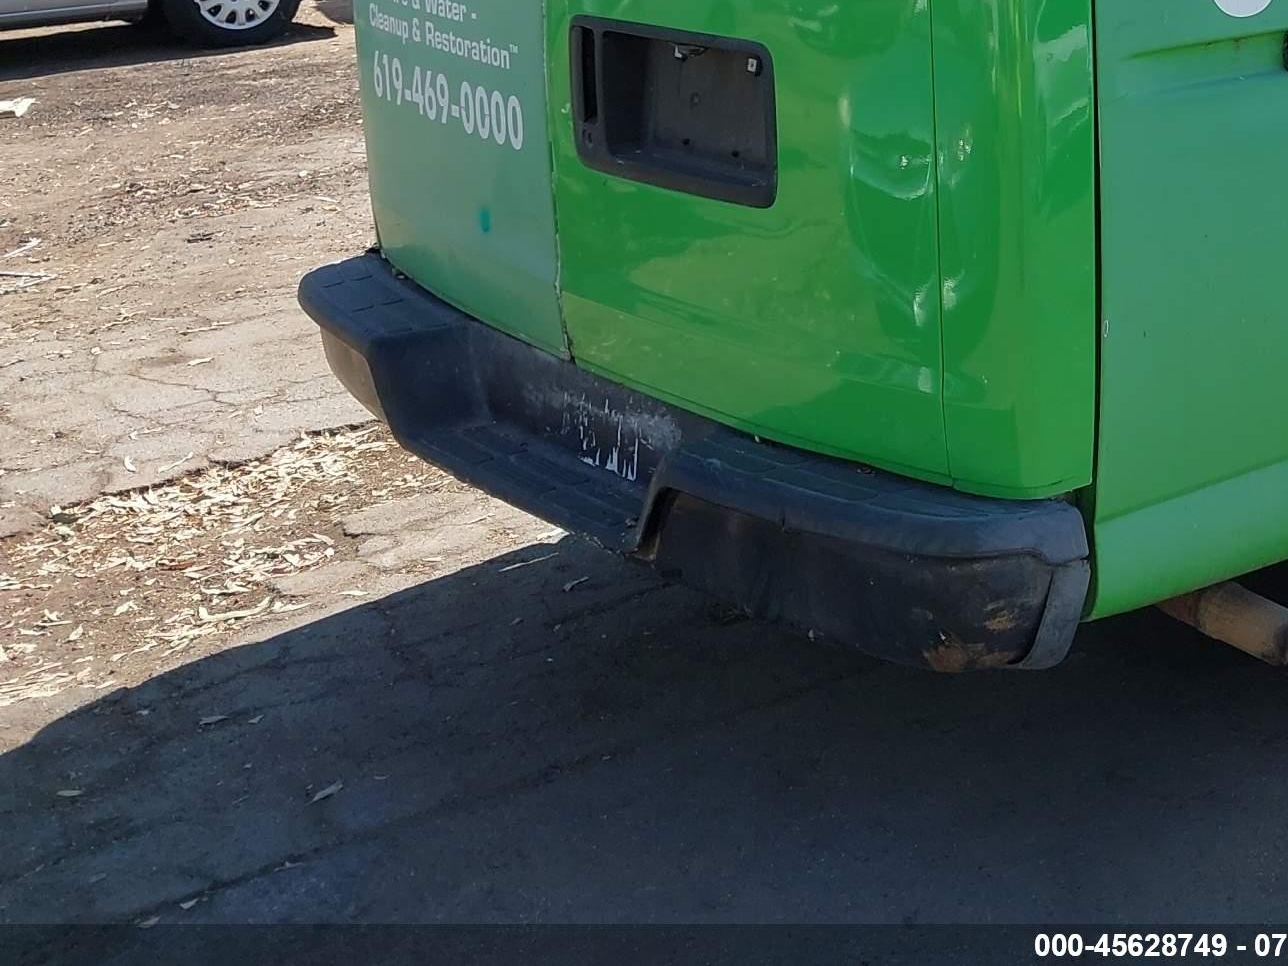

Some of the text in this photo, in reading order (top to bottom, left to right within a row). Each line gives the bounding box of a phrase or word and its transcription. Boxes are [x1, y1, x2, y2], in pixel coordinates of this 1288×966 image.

[369, 2, 409, 44] Cleanup
[412, 17, 422, 42] &
[373, 50, 524, 151] 619-469-0000
